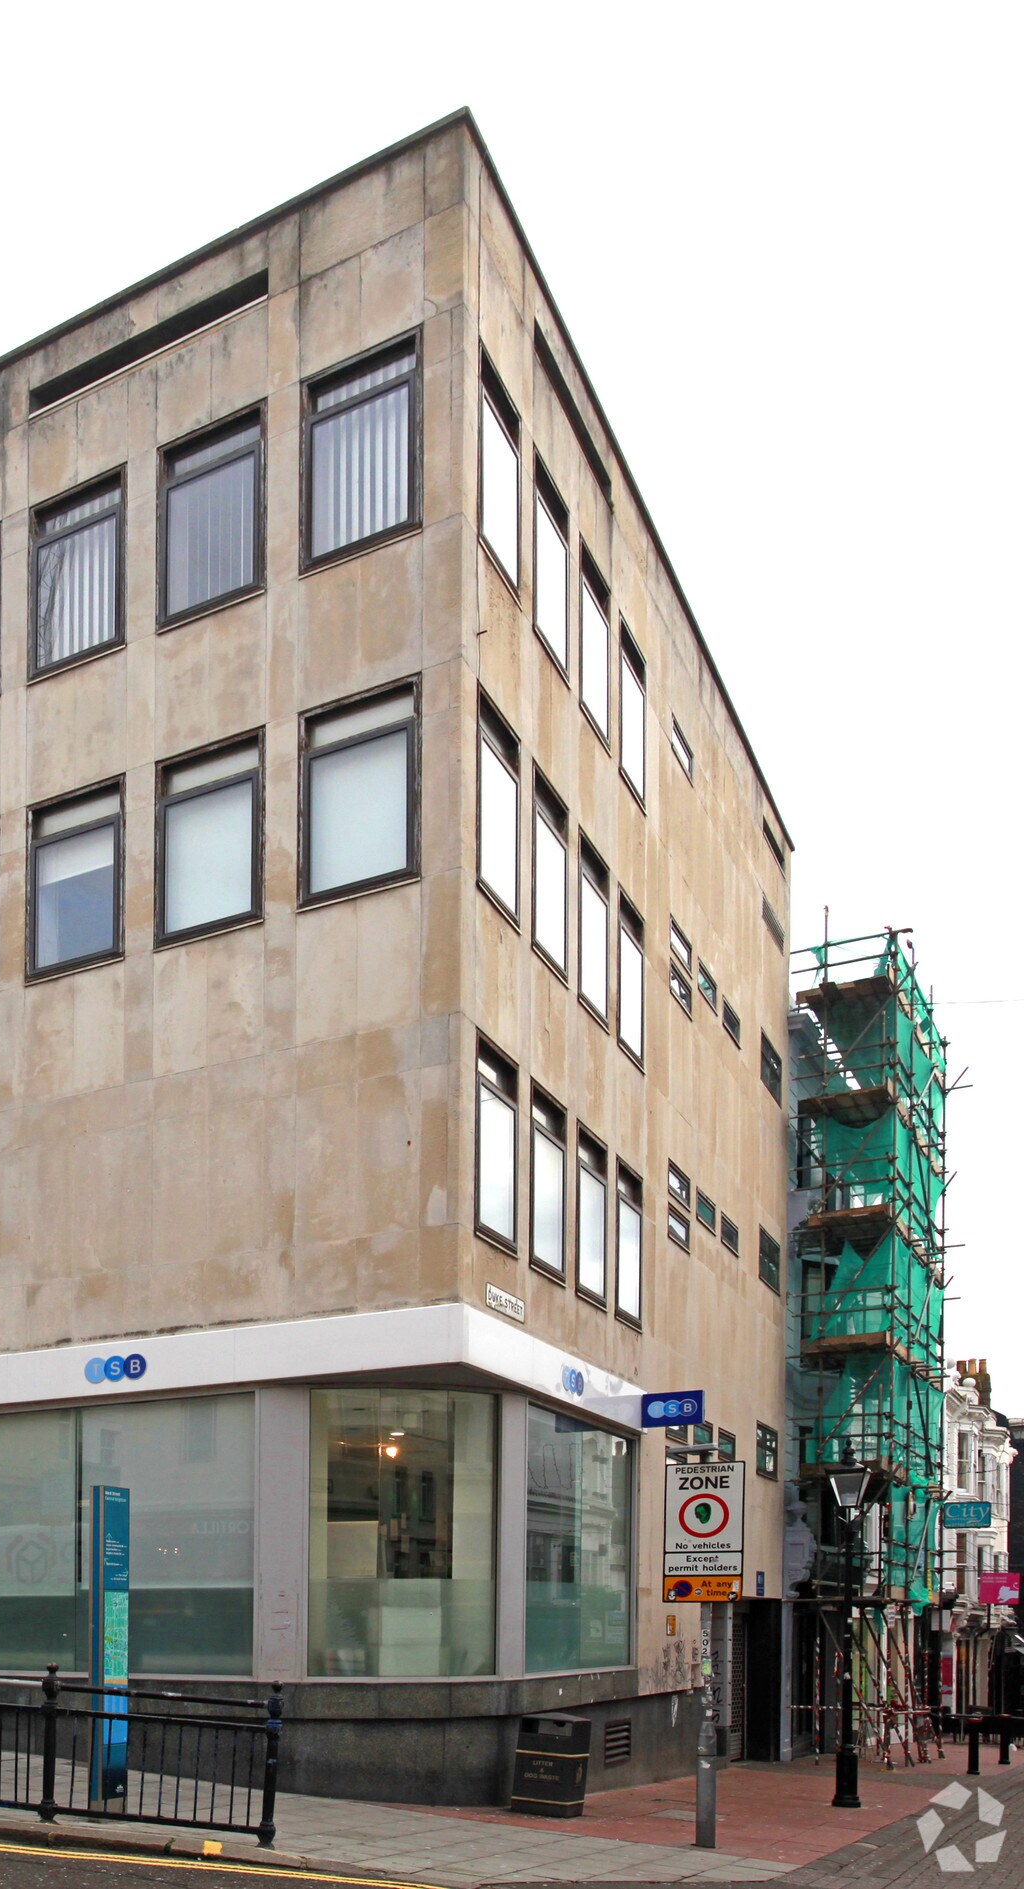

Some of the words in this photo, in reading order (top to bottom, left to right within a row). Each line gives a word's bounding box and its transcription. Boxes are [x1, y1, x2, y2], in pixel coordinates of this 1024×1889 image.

[504, 1298, 523, 1316] STREET
[89, 1356, 143, 1380] TSB
[563, 1369, 583, 1393] TSB
[650, 1400, 694, 1417] TSB
[675, 1465, 734, 1474] PEDESTRIAN
[678, 1475, 730, 1490] ZONE
[945, 1503, 990, 1524] City
[675, 1542, 688, 1550] No
[668, 1564, 698, 1573] permit
[703, 1564, 738, 1572] holders
[716, 1581, 733, 1589] any
[706, 1589, 727, 1597] time
